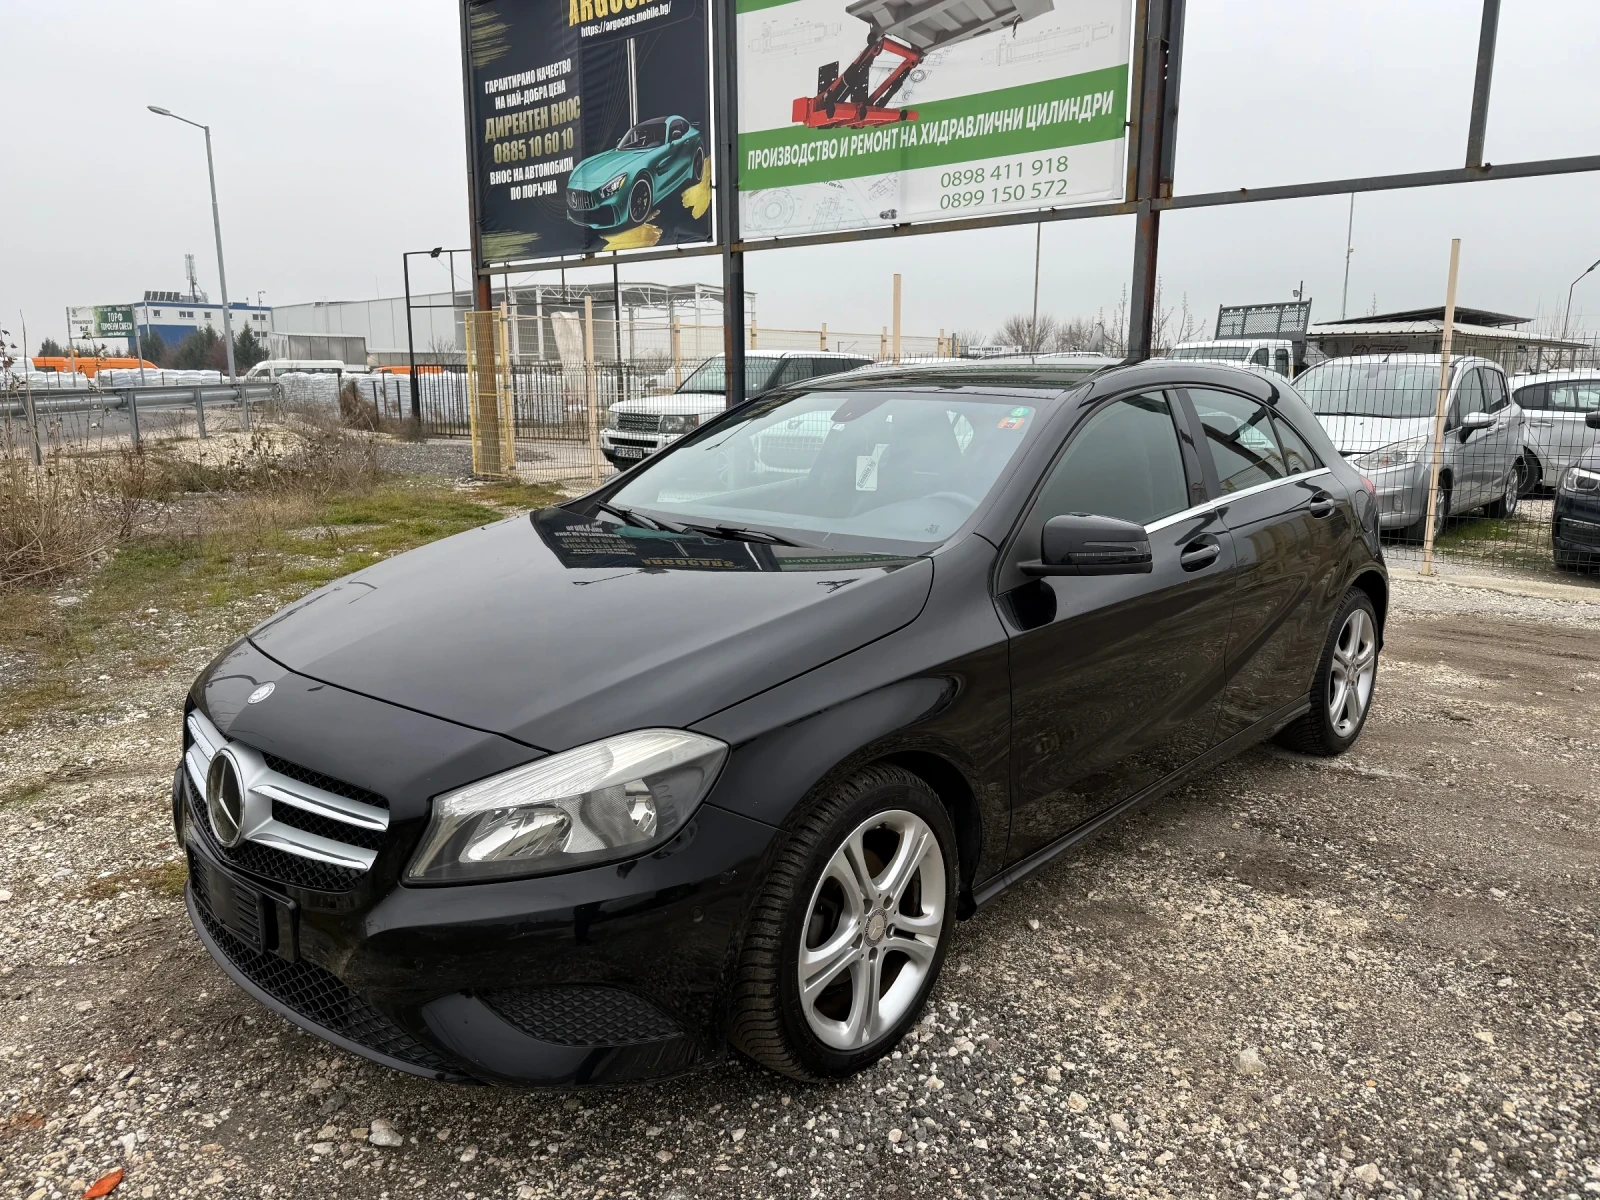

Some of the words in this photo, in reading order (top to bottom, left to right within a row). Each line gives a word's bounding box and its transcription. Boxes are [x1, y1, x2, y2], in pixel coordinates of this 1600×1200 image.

[581, 1, 672, 37] https://argocars.mobile.bg/
[485, 69, 535, 94] ГАРАНТИРАНО
[537, 58, 571, 81] КАЧЕСТВО
[495, 96, 505, 109] НА
[506, 88, 548, 108] НАЙ-ДОБРА
[549, 80, 566, 98] ЦЕНА
[485, 106, 548, 143] ДИРЕКТЕН
[551, 96, 580, 123] ВНОС
[748, 136, 838, 170] ПРОИЗВОДСТВО
[839, 136, 848, 157] И
[850, 128, 899, 156] РЕМОНТ
[900, 127, 917, 148] НА
[920, 102, 1025, 145] ХИДРАВЛИЧНИ
[1026, 90, 1114, 131] ЦИЛИНДРИ
[494, 142, 526, 164] 0885
[528, 138, 541, 158] 10
[544, 133, 559, 154] 60
[561, 128, 574, 150] 10
[490, 170, 512, 185] ВНОС
[513, 169, 524, 182] НА
[525, 156, 573, 180] АВТОМОБИЛИ
[940, 167, 985, 188] 0898
[991, 161, 1023, 182] 411
[1031, 155, 1068, 175] 918
[510, 187, 521, 200] ПО
[522, 180, 557, 199] ПОРЪЧКА
[939, 189, 985, 209] 0899
[991, 184, 1025, 203] 150
[1030, 179, 1067, 199] 572
